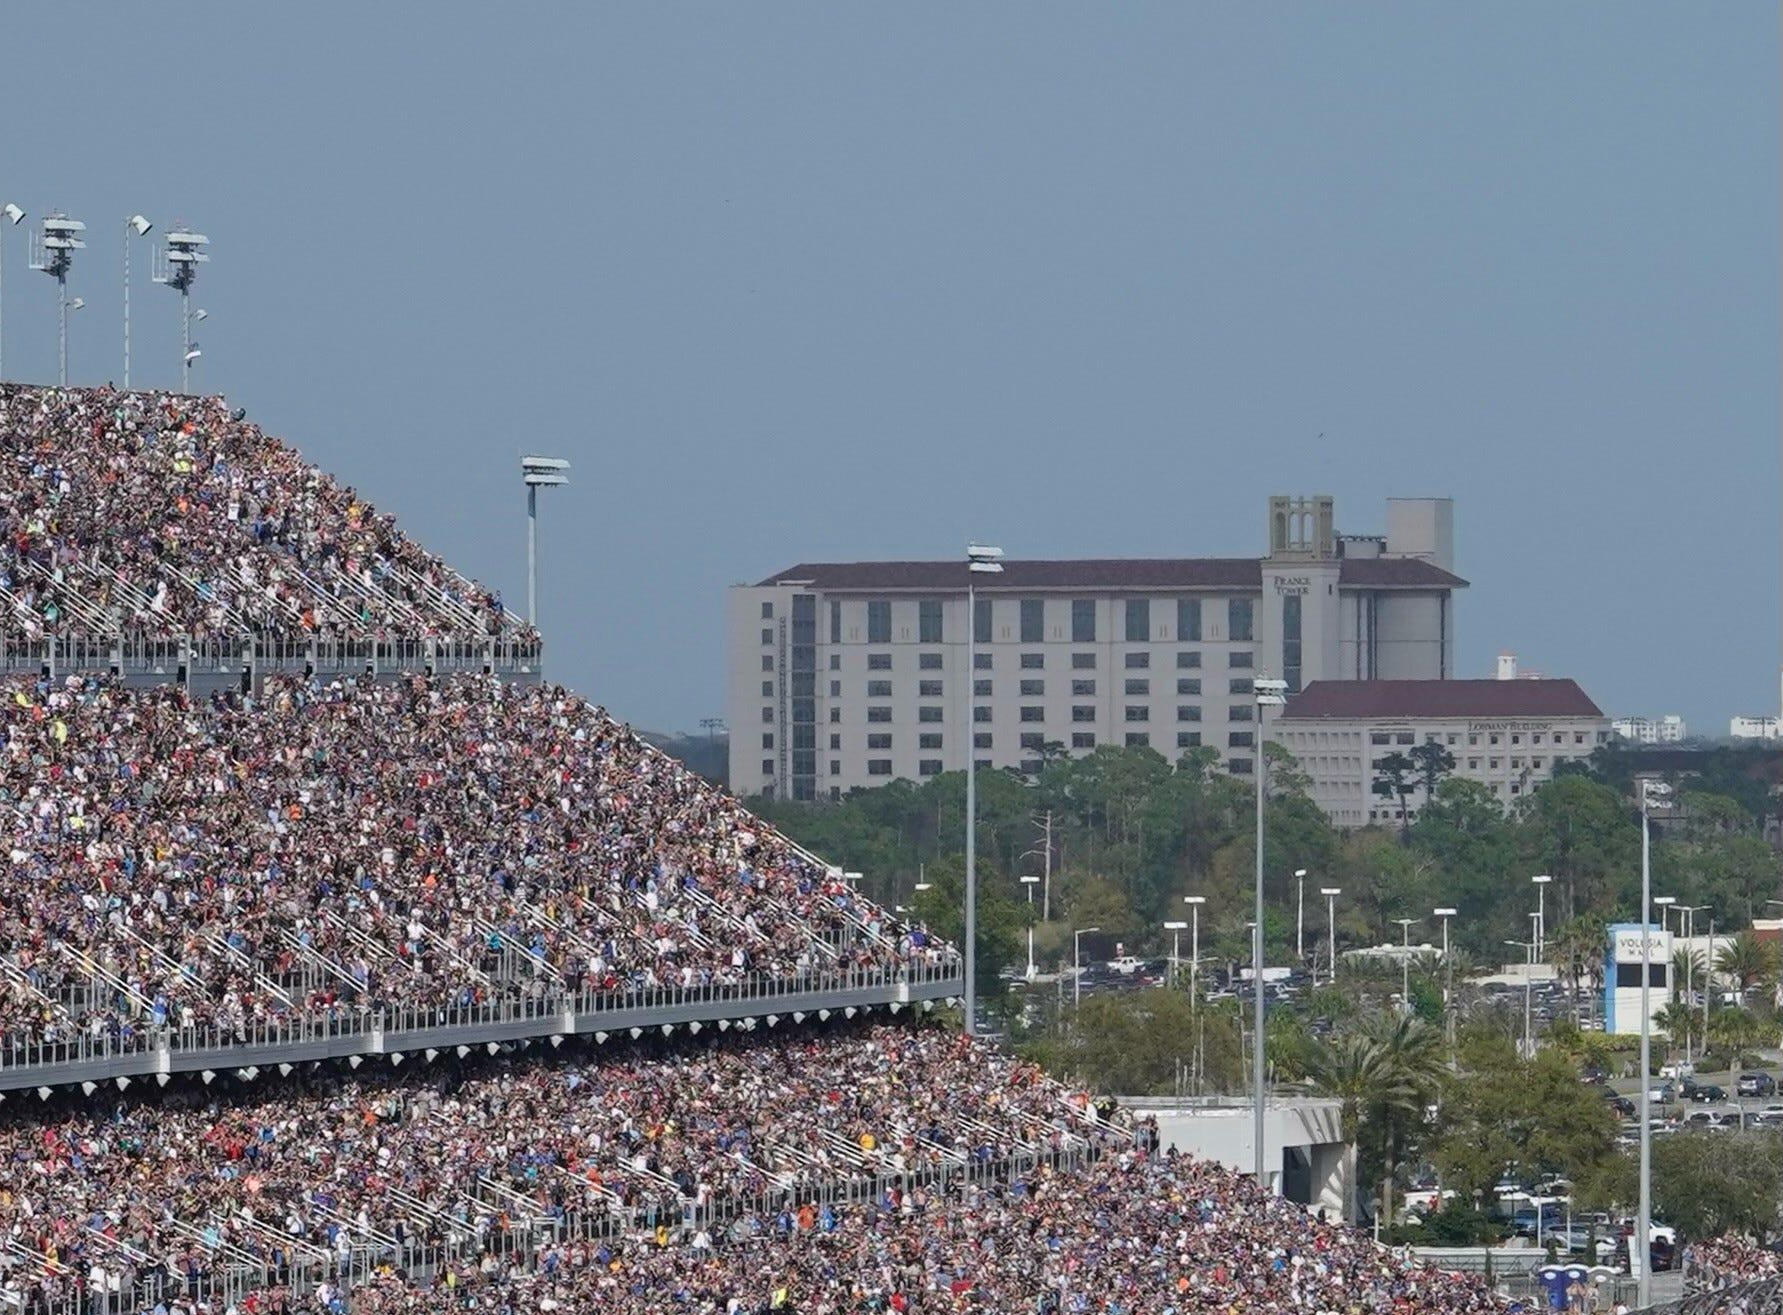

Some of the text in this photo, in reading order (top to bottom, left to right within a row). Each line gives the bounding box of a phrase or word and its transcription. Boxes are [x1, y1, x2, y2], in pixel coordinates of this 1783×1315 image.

[1274, 575, 1312, 586] FRANCE
[1276, 585, 1310, 597] TOWER
[1510, 720, 1552, 731] BUILDING
[1628, 949, 1655, 957] MAL
